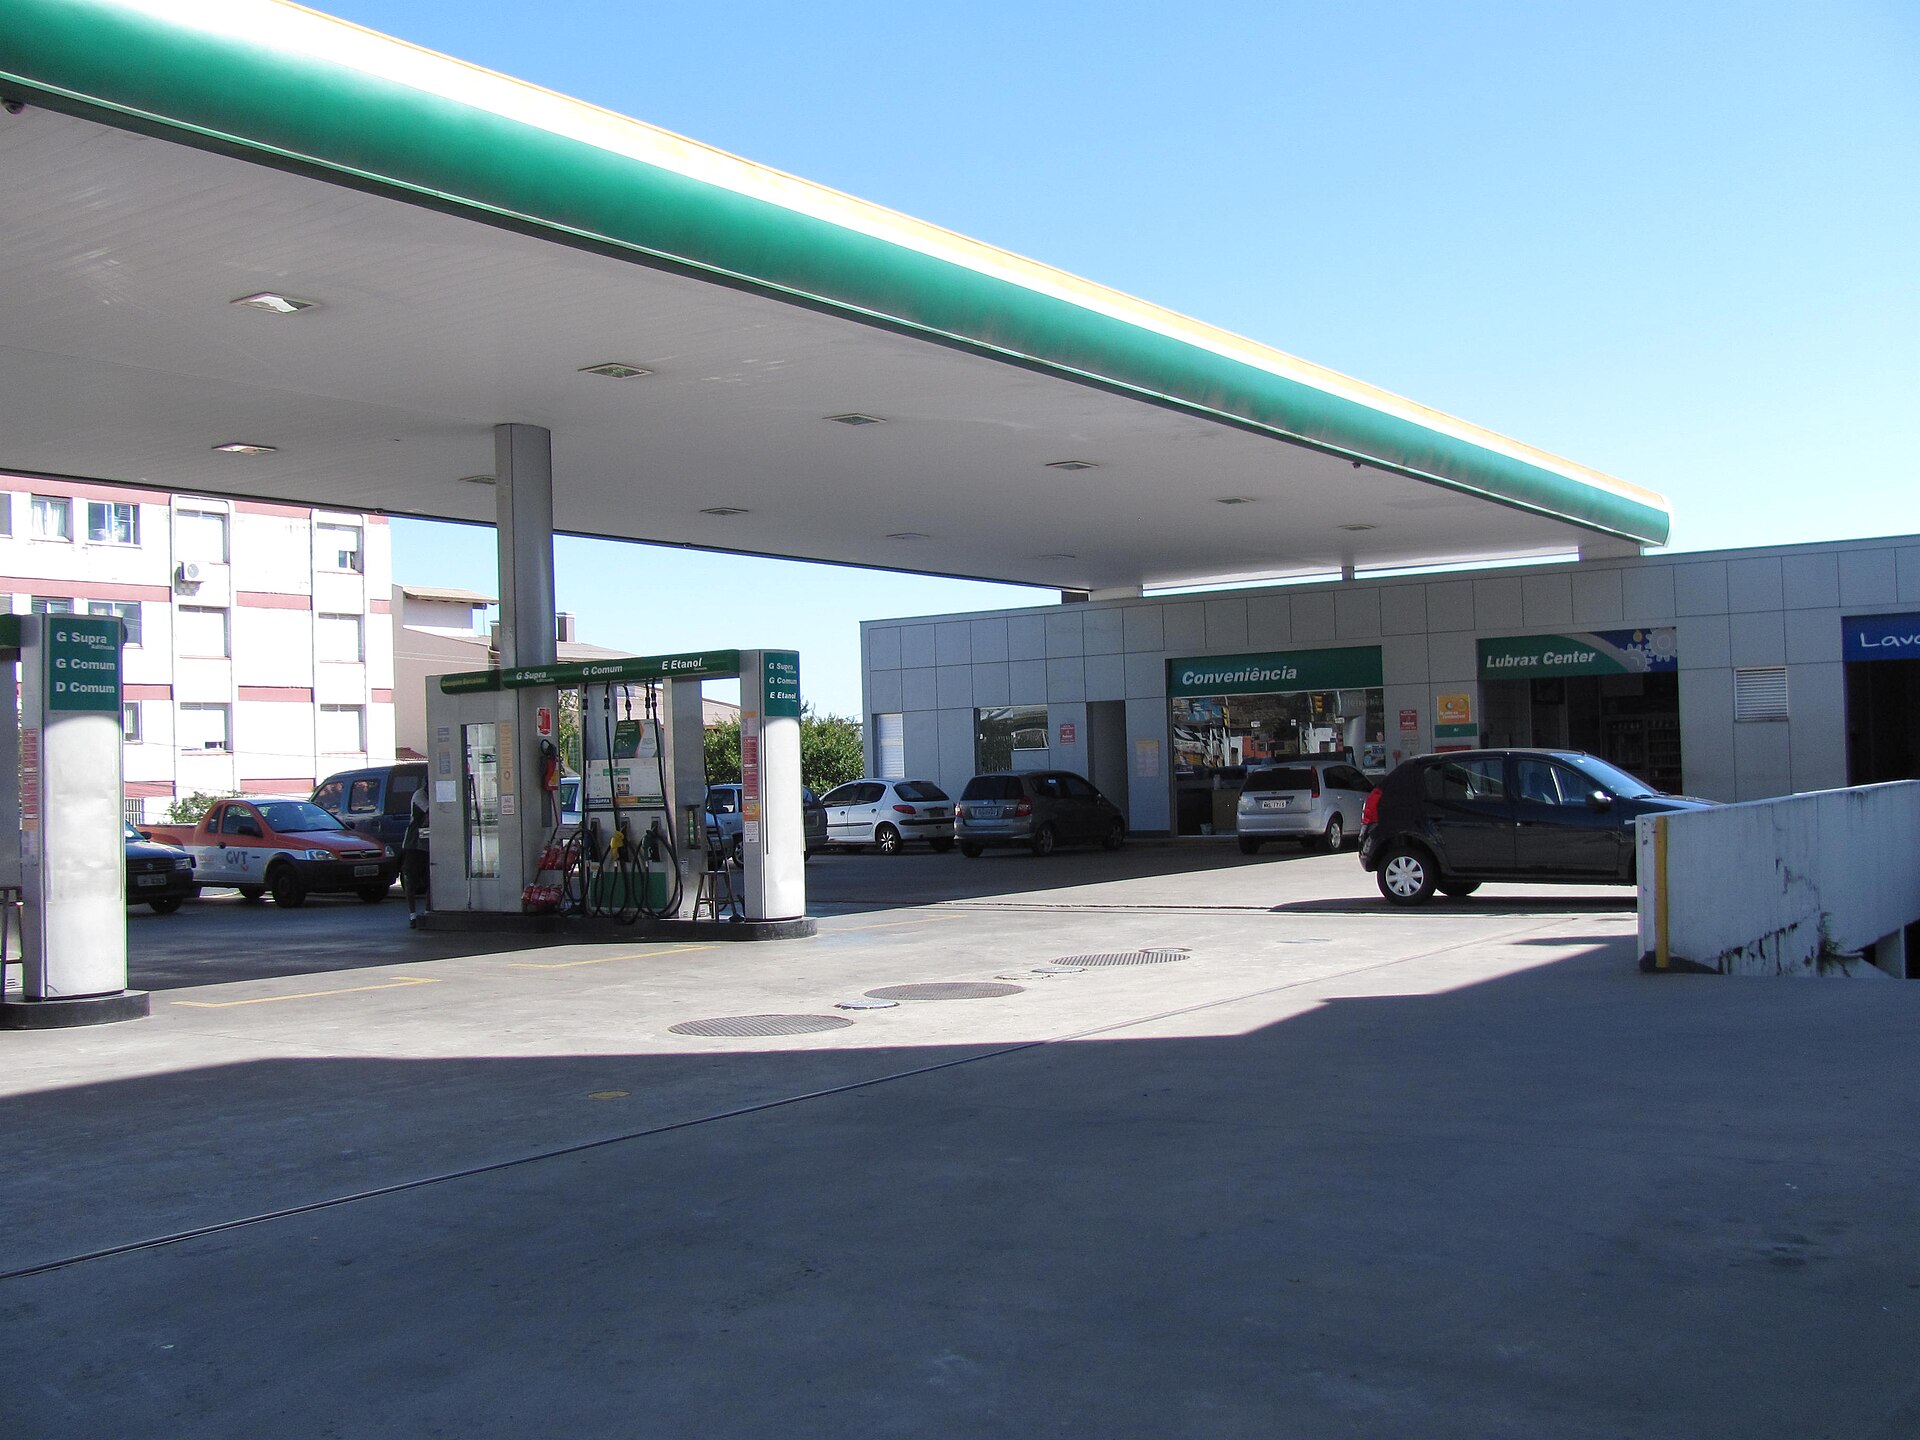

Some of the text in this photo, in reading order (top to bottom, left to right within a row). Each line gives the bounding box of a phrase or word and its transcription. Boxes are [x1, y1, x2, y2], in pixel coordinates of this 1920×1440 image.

[56, 631, 107, 645] G Supra
[56, 658, 115, 670] G Comum
[662, 657, 702, 670] E Etanol
[1486, 651, 1596, 668] Lubrax Center
[582, 664, 623, 676] G Comum
[768, 662, 794, 671] G Supra
[516, 672, 523, 680] G
[524, 671, 547, 681] Supra
[1182, 665, 1297, 685] Conveniência
[56, 681, 115, 693] D Comum
[769, 691, 796, 699] E Etanol
[226, 851, 248, 865] GVT
